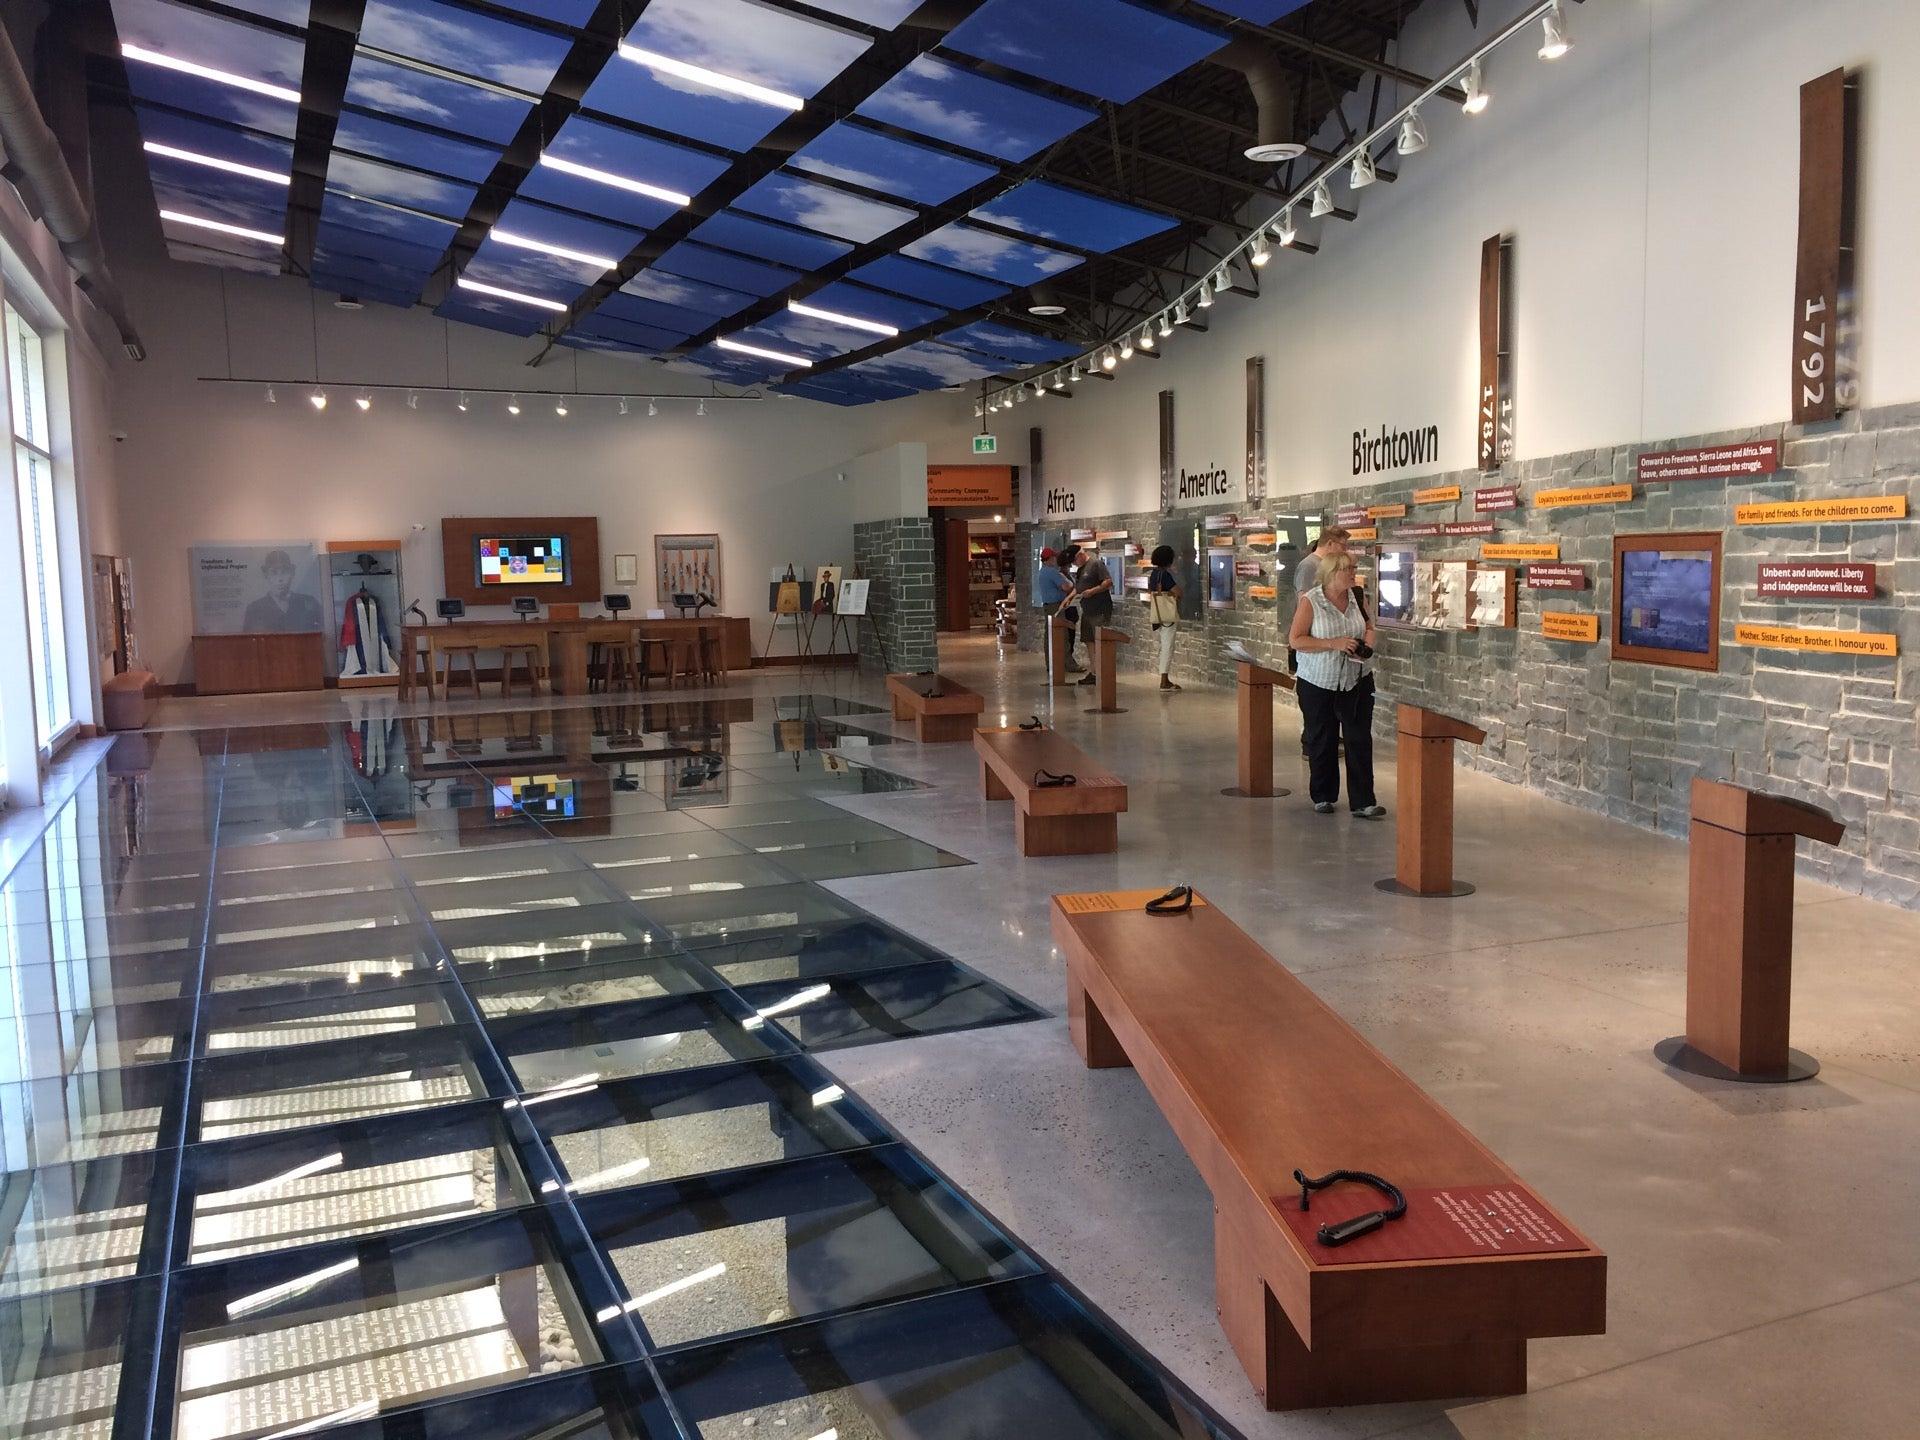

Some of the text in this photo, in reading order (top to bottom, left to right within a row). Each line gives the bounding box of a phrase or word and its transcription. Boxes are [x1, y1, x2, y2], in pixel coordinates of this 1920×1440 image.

[1802, 295, 1826, 408] 1792
[1482, 384, 1493, 459] 1784
[1353, 424, 1438, 475] Birchtown
[1641, 446, 1773, 467] Onward to Freetown, Sierra Leone and Africa. Some
[1641, 469, 1658, 479] leave,
[1659, 467, 1677, 477] others
[1678, 465, 1698, 476] remain.
[1708, 462, 1731, 472] continue
[1732, 462, 1740, 471] the
[1741, 460, 1762, 472] struggle.
[1179, 462, 1227, 499] America
[1047, 487, 1075, 514] Africa
[1738, 504, 1896, 521] For family and friends. For the children to come.
[1538, 566, 1547, 574] have
[1763, 567, 1863, 581] Unbent and unbowed. Liberty
[1762, 581, 1868, 593] and independence will be ours.
[1740, 630, 1888, 652] Mother. Sister. Father. Brother. I honour you.
